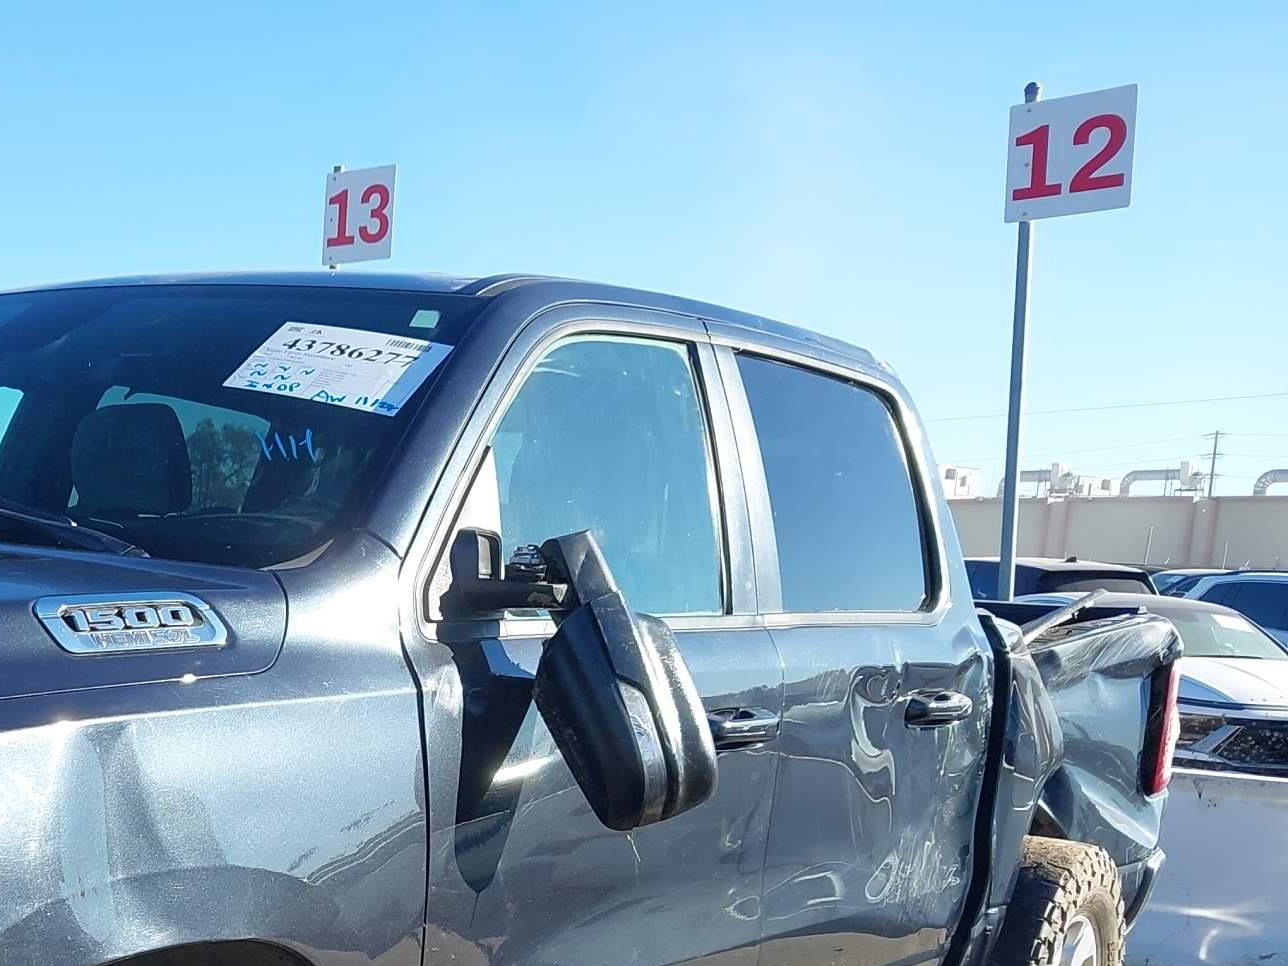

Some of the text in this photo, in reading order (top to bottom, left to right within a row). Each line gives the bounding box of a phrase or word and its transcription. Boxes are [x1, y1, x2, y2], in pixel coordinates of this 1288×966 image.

[1012, 113, 1128, 201] 12
[326, 183, 390, 248] 13
[281, 337, 420, 368] 43786277
[61, 604, 196, 632] 1500
[90, 631, 151, 649] HEMI
